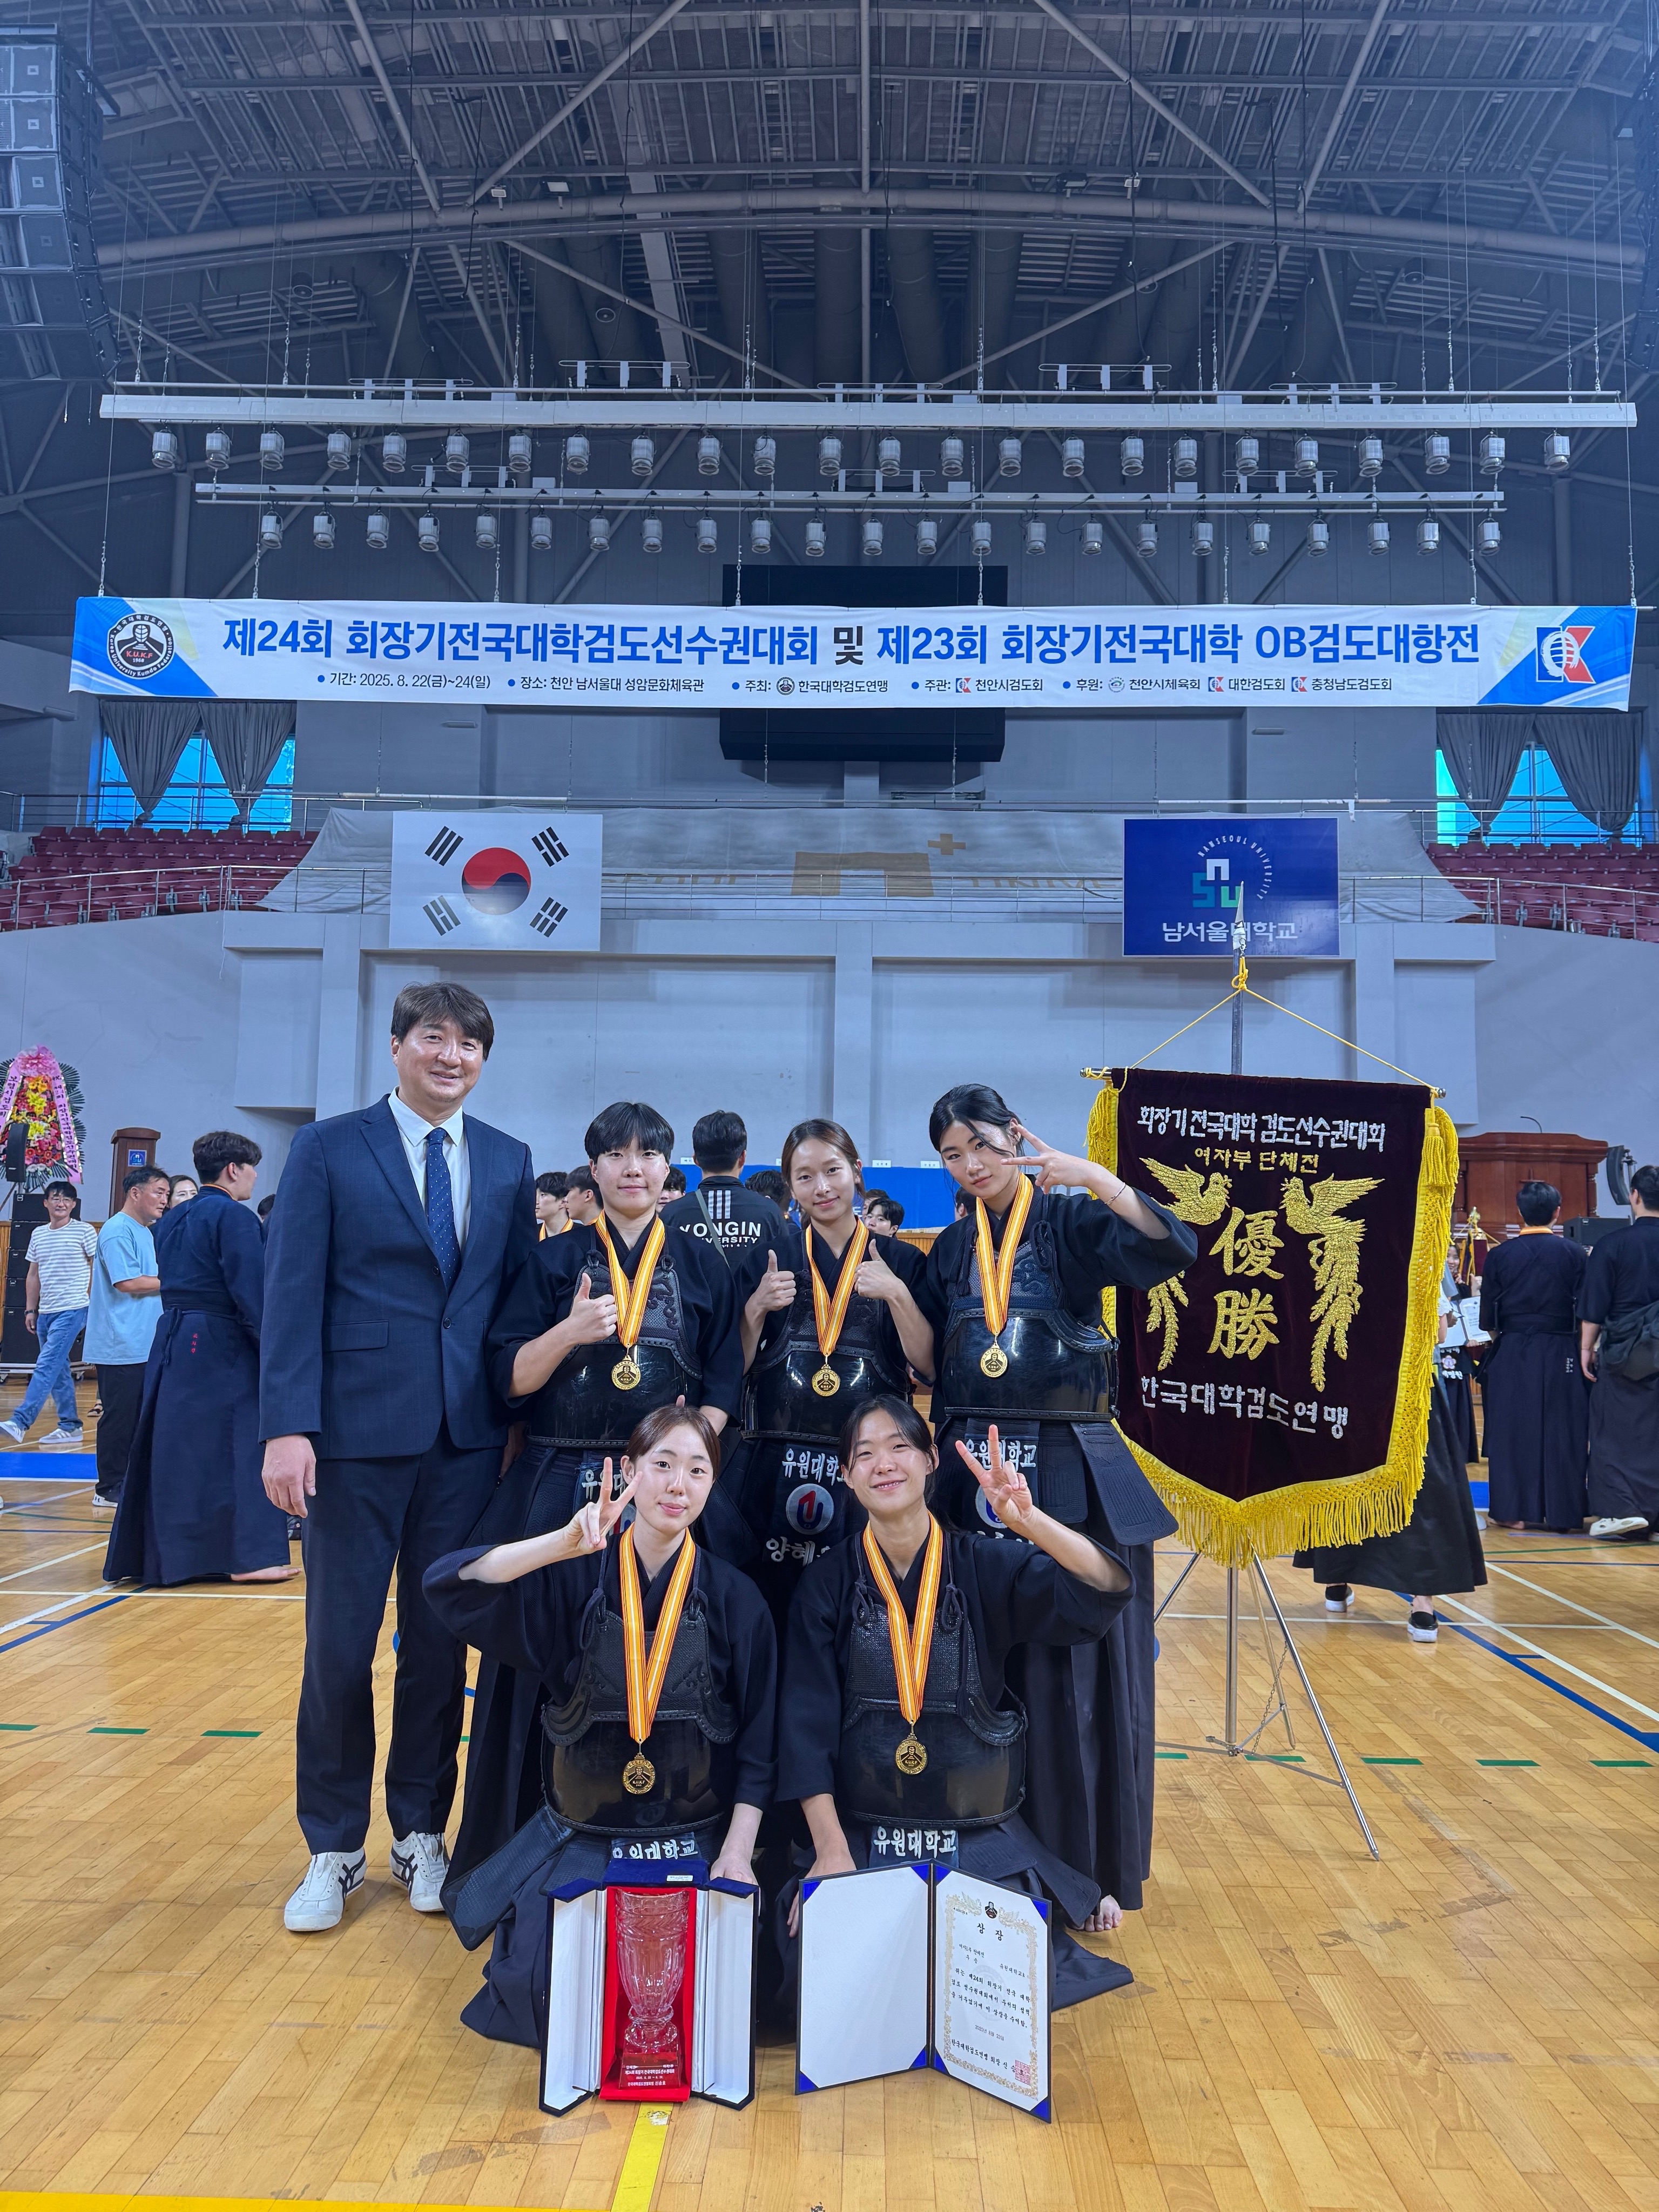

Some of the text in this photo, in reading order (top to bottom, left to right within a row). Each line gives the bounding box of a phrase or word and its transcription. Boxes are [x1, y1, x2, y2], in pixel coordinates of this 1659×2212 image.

[223, 618, 1479, 665] 제24회 회장기전국대학검도선수권대회 및 제23회 회장기전국대학 OB검도대항전
[111, 653, 137, 677] University
[137, 667, 157, 676] Kumdo
[157, 637, 172, 668] Federation
[330, 673, 491, 689] 기간: 2025. 8. 22(금)~24(일)
[521, 676, 704, 692] 장소: 천안 남서울대 성암문화체육관
[745, 679, 771, 693] 주최:
[798, 679, 888, 694] 한국대학검도연맹
[925, 678, 1043, 693] 주관: 천안시검도회
[1076, 678, 1103, 691] 후원:
[1129, 678, 1201, 691] 천안시체육회
[1229, 678, 1285, 691] 대한검도회
[1312, 678, 1392, 691] 충청남도검도회
[1251, 842, 1272, 900] UNIVERSITY
[1137, 1106, 1386, 1152] 회장기 전국대학 검도선수권대회
[1194, 1148, 1319, 1174] 여자부 단체전
[1206, 1206, 1285, 1360] 優勝
[1141, 1375, 1348, 1439] 한국대학검도연맹
[766, 1536, 831, 1567] 양혜
[873, 1826, 957, 1859] 유원대학교
